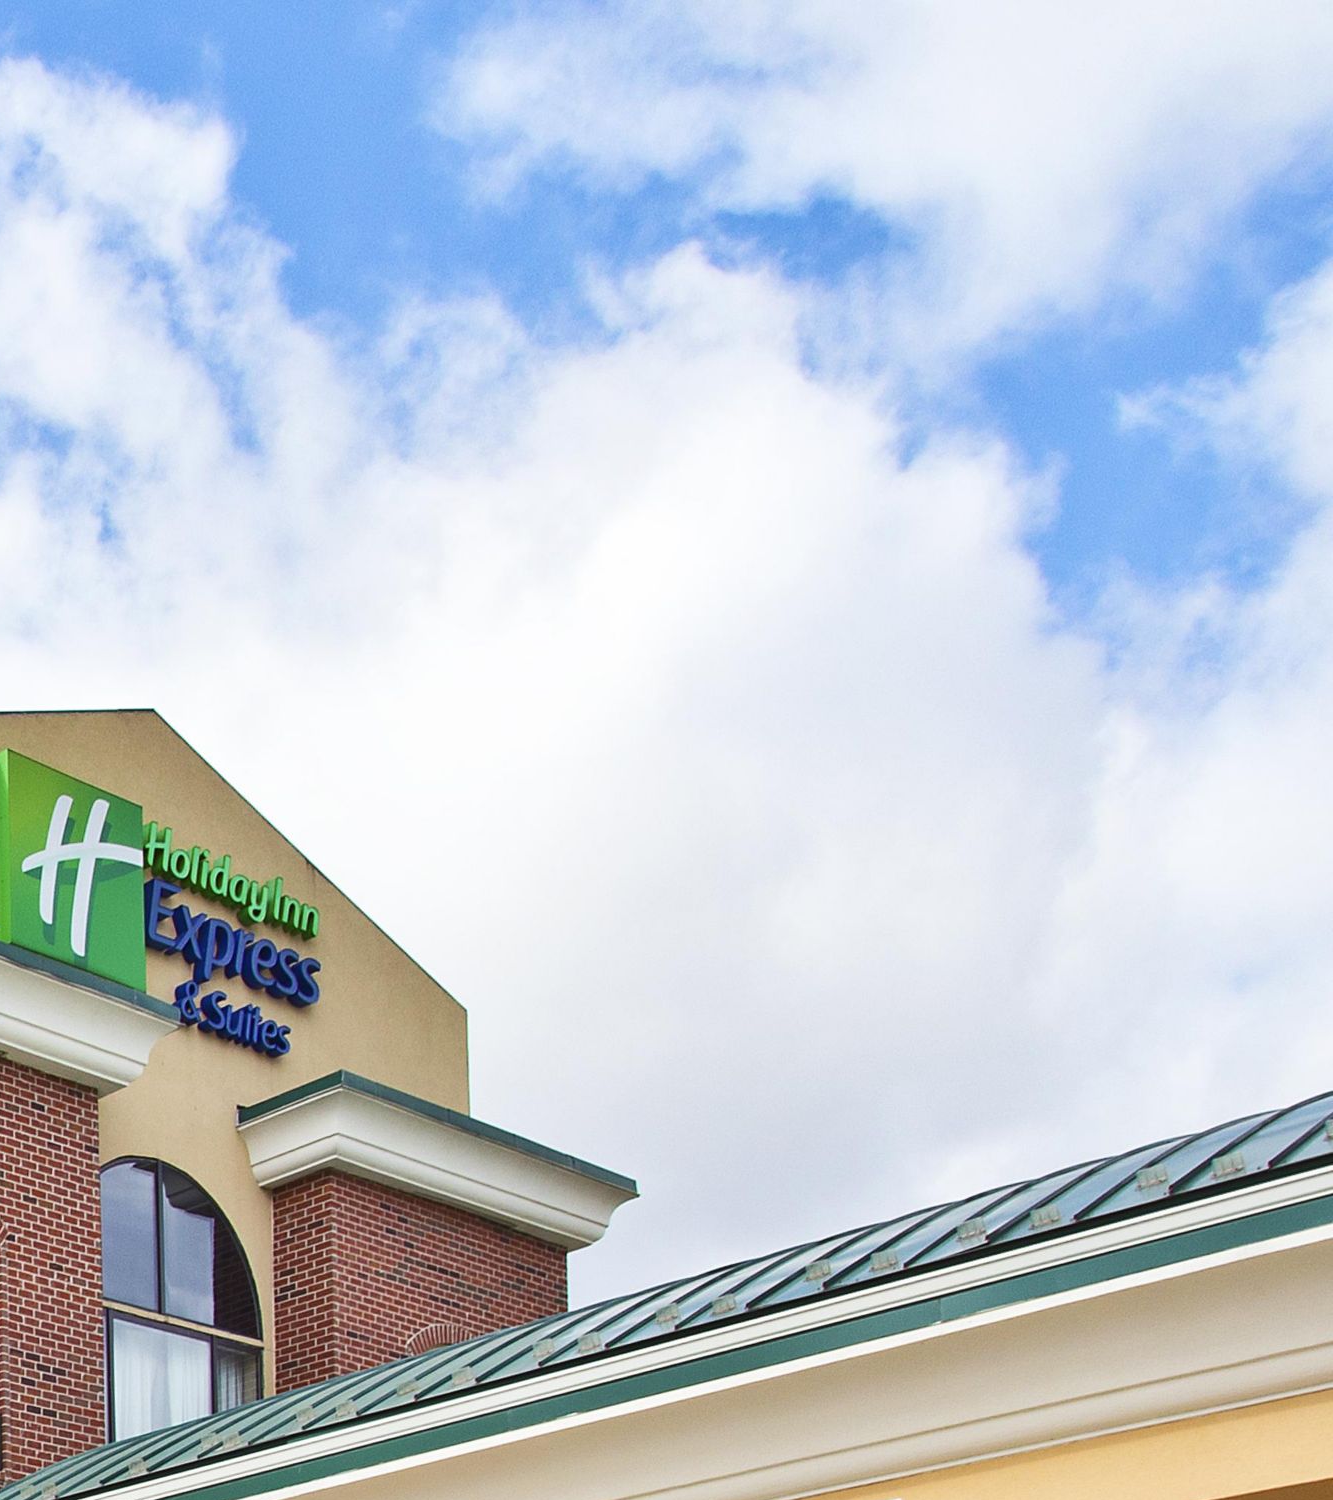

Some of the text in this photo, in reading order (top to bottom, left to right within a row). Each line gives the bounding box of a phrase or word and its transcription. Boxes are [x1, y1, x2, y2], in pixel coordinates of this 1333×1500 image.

[144, 821, 320, 940] Holiday Inn
[144, 878, 321, 1008] Express
[174, 980, 291, 1058] & Suites
